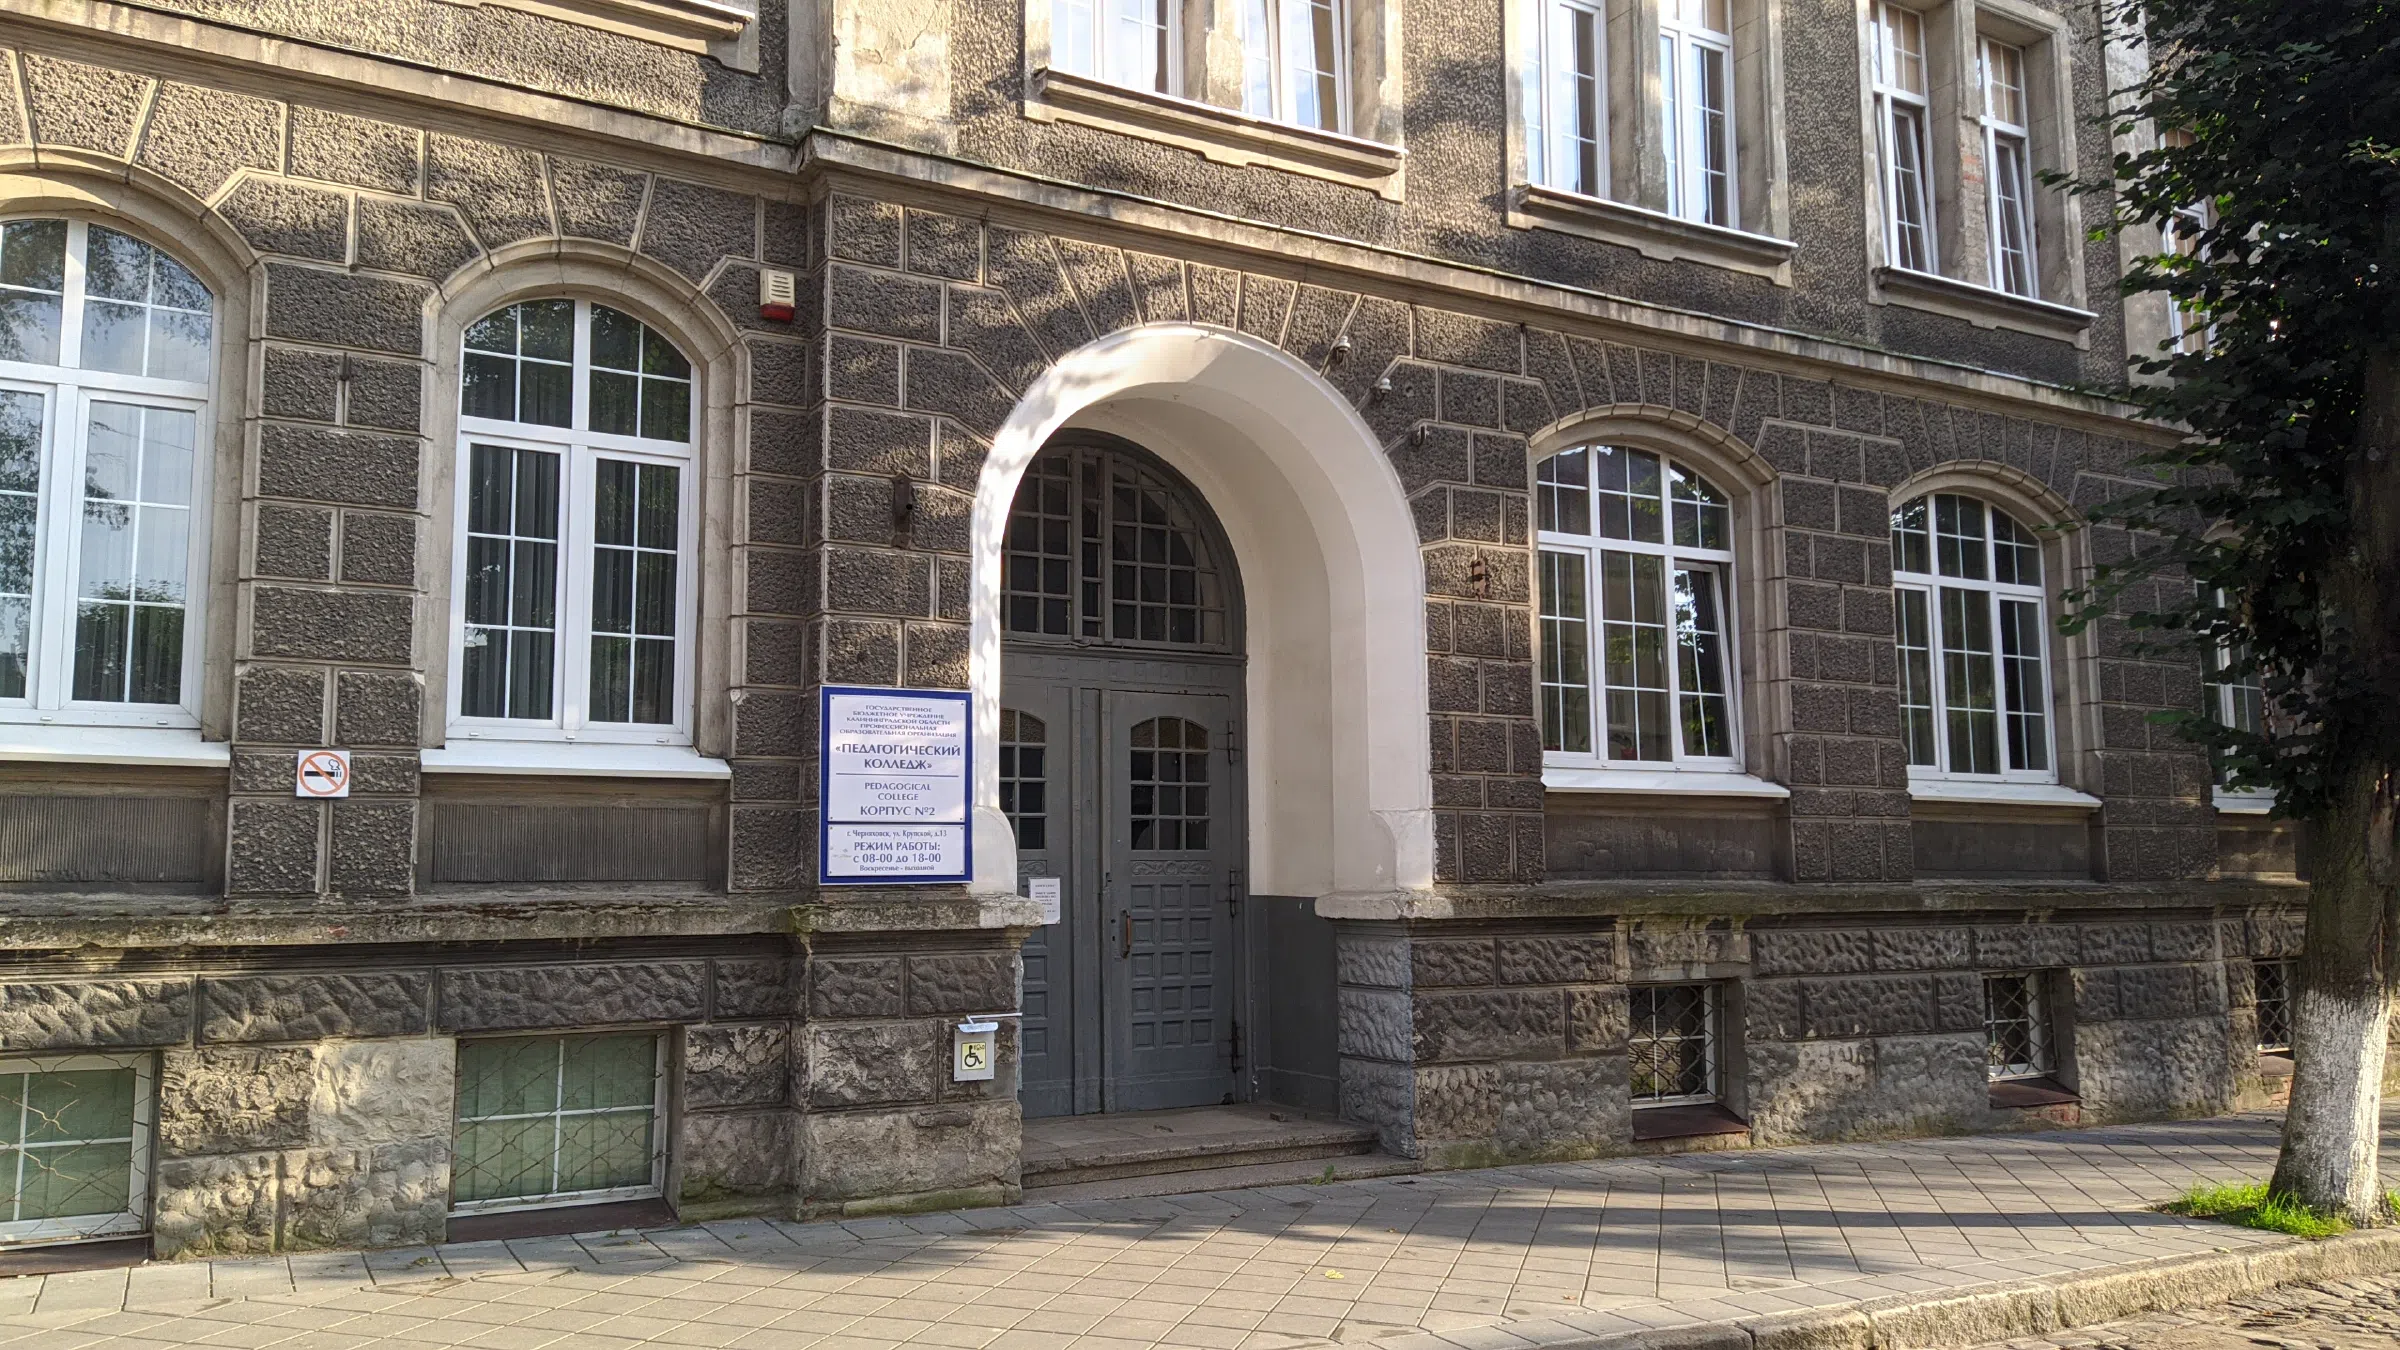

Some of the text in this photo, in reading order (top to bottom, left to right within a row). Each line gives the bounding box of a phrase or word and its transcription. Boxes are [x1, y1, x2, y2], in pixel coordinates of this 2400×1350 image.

[835, 743, 961, 756] «ПЕДАГОГИЧЕСКИЙ
[864, 758, 933, 770] КОЛЛЕДЖ»
[864, 782, 932, 791] PEDAGOGICAL
[877, 793, 919, 801] COLLEGE
[860, 806, 911, 816] КОРПУС
[854, 841, 941, 851] РЕЖИМ РАБОТЫ:
[862, 853, 893, 863] 08-00
[895, 855, 909, 863] до
[912, 853, 941, 863] 18-00
